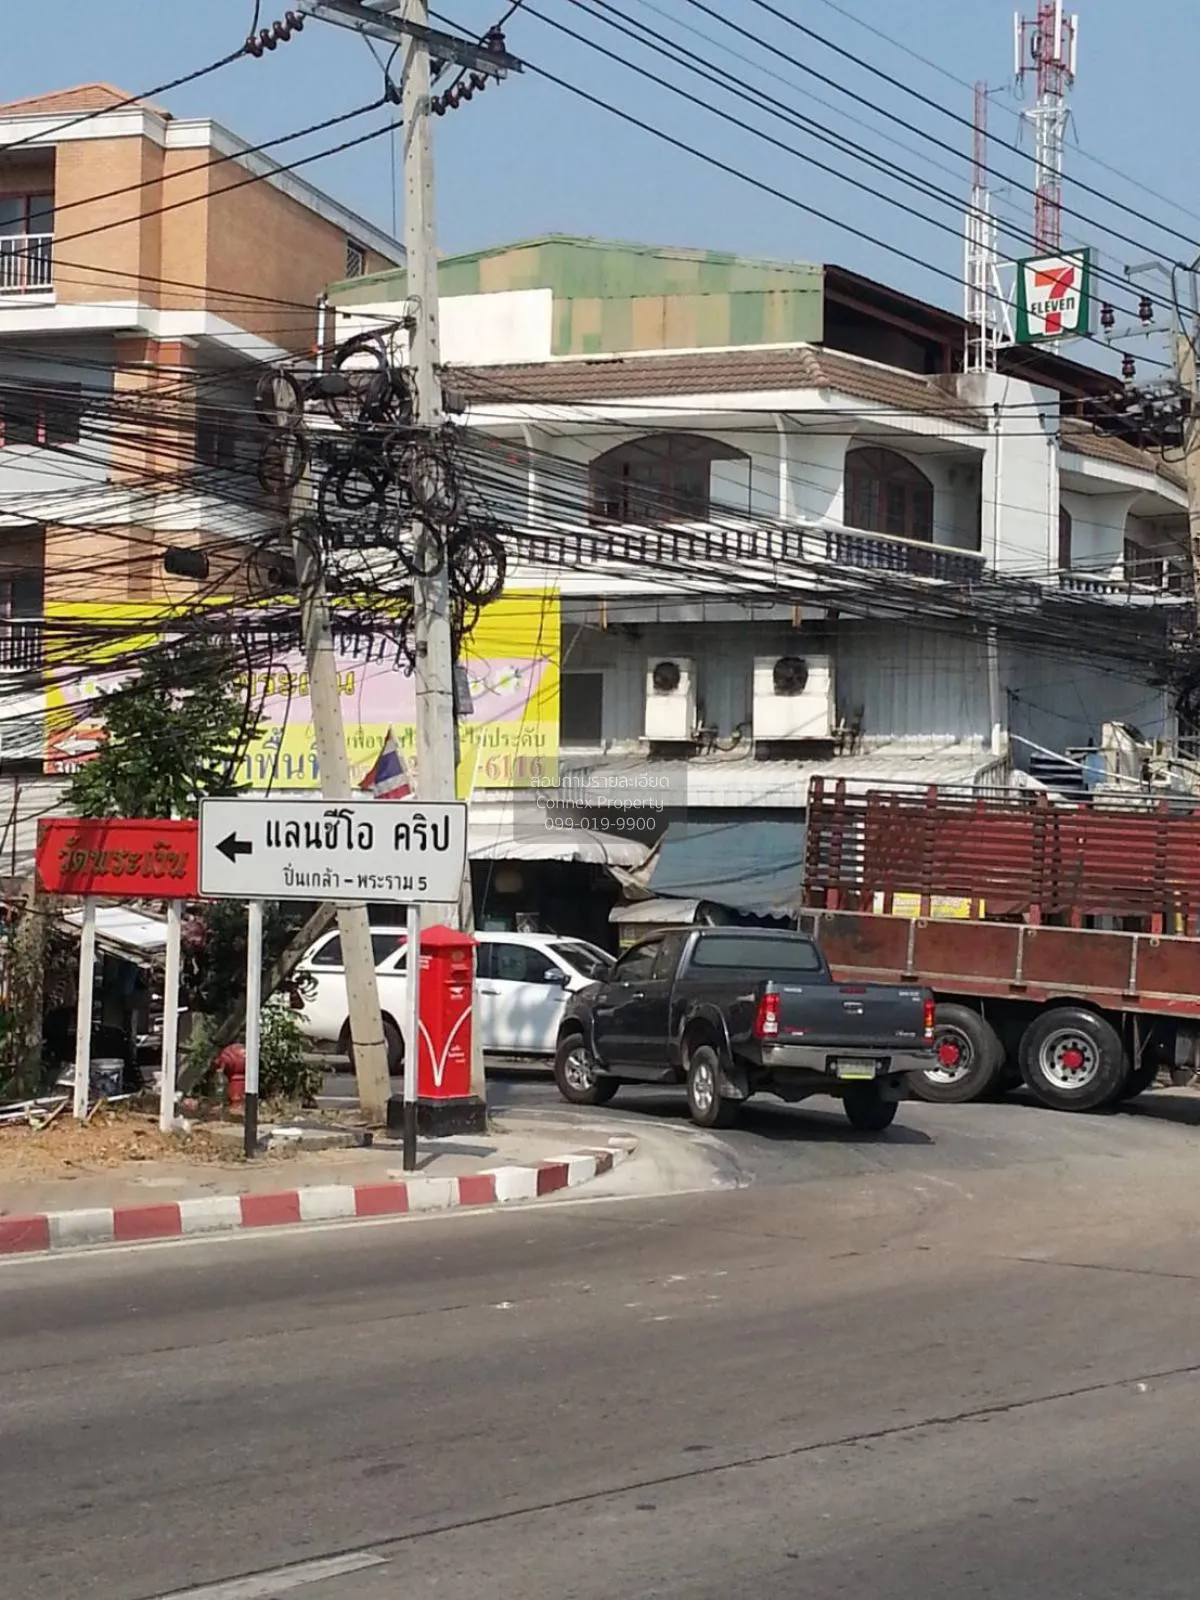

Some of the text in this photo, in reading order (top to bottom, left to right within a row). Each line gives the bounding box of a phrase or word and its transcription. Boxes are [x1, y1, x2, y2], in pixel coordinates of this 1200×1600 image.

[1034, 266, 1075, 334] 7
[394, 813, 450, 851] คริป
[357, 874, 413, 890] พระราม
[417, 876, 428, 891] 5
